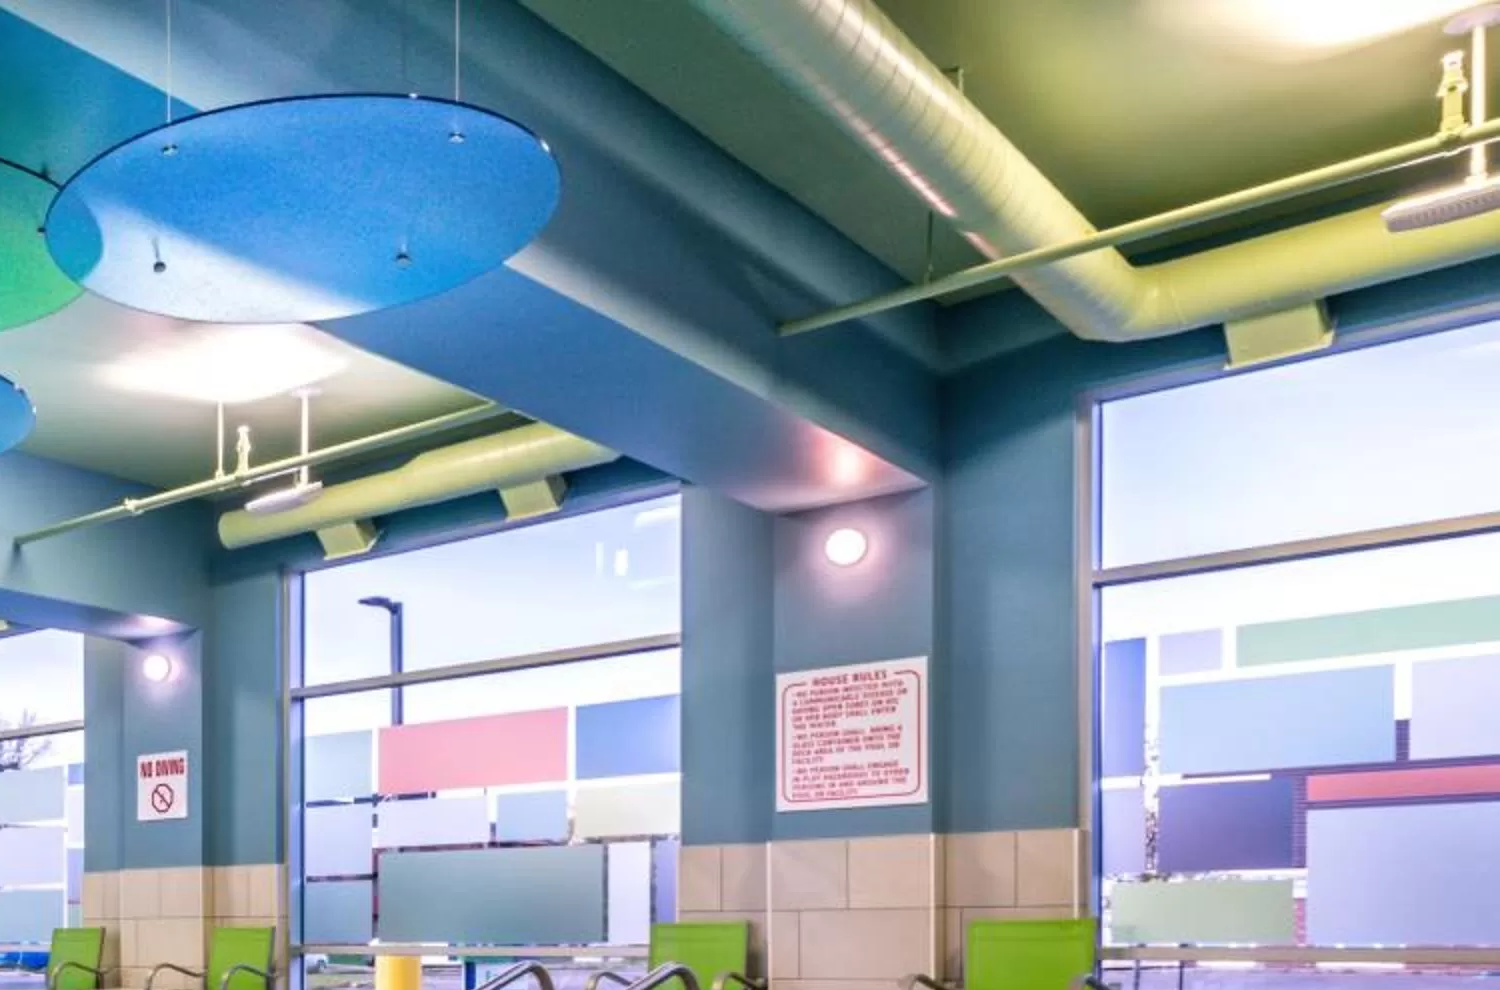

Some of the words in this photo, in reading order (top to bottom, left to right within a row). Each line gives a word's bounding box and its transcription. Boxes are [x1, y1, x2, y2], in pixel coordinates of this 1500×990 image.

[812, 673, 849, 686] HOUSE
[852, 670, 887, 682] RULES
[141, 761, 152, 778] NO
[155, 757, 184, 776] DIVING
